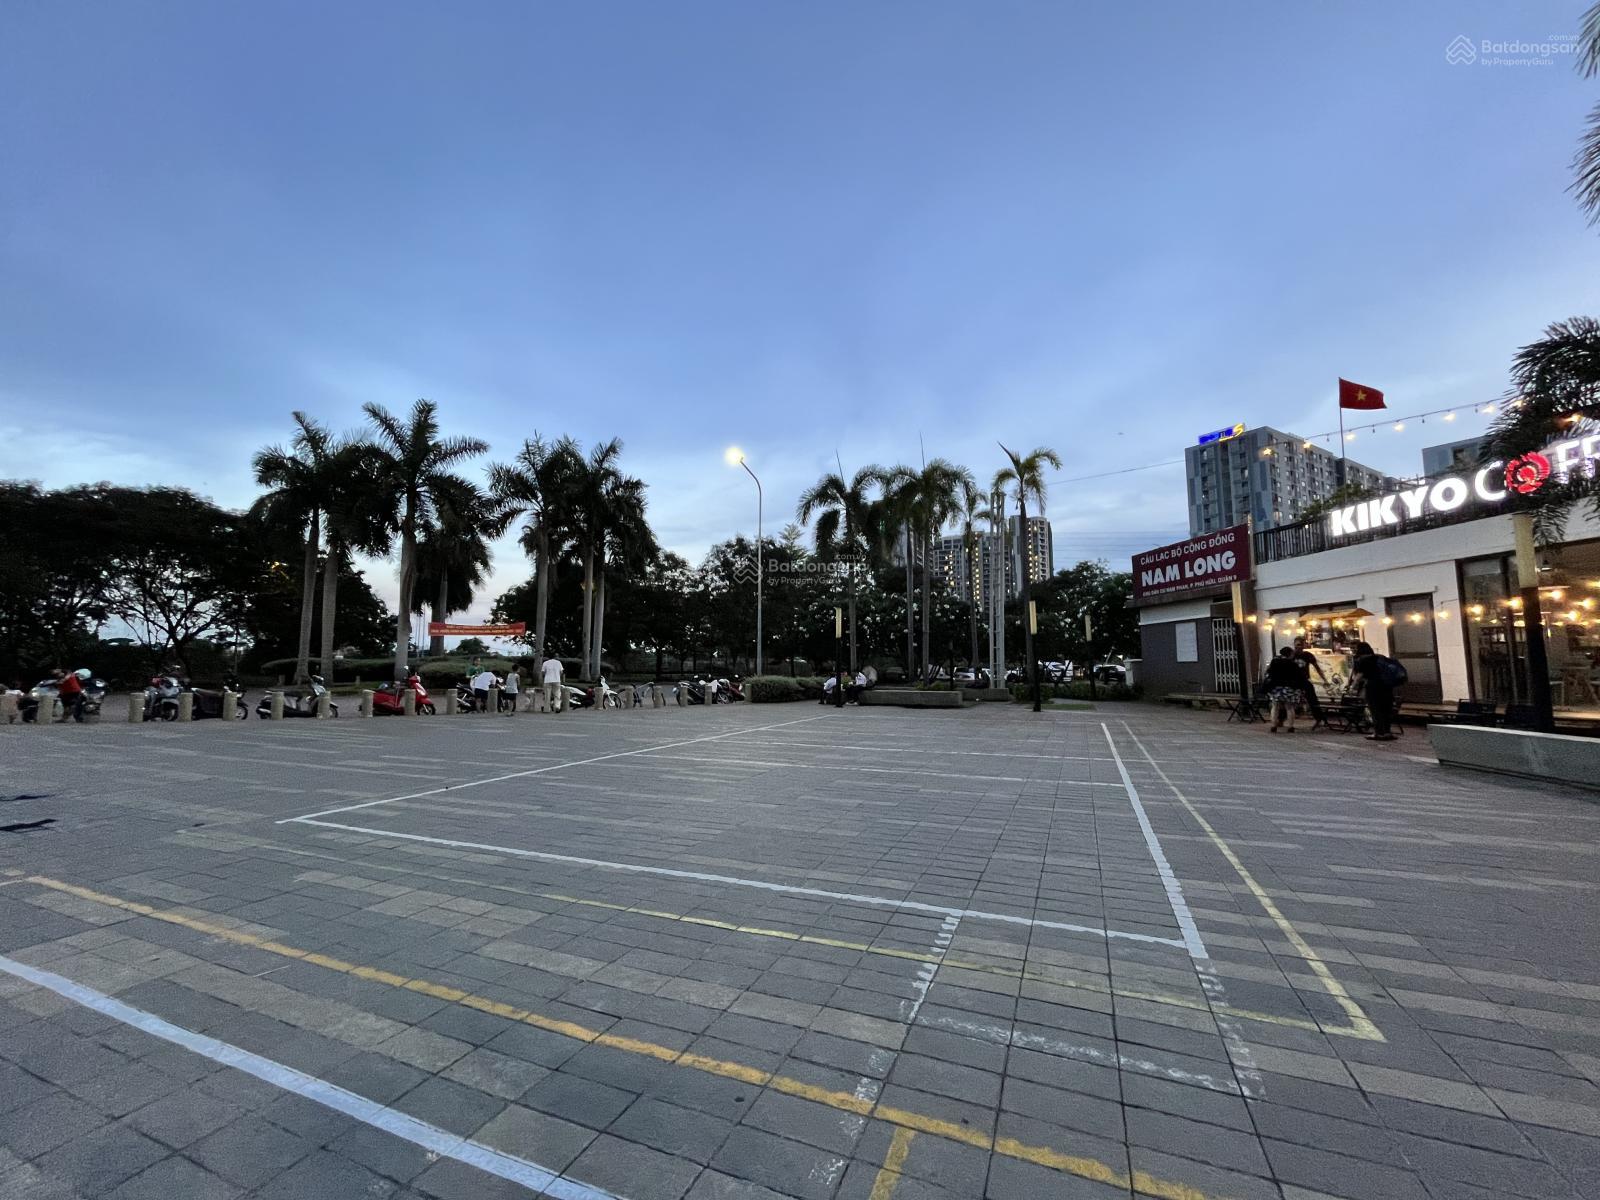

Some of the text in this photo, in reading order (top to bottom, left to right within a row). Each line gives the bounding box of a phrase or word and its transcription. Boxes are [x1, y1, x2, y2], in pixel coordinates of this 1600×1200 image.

[1331, 477, 1468, 537] KIKYO
[1141, 550, 1236, 587] NAM LONG
